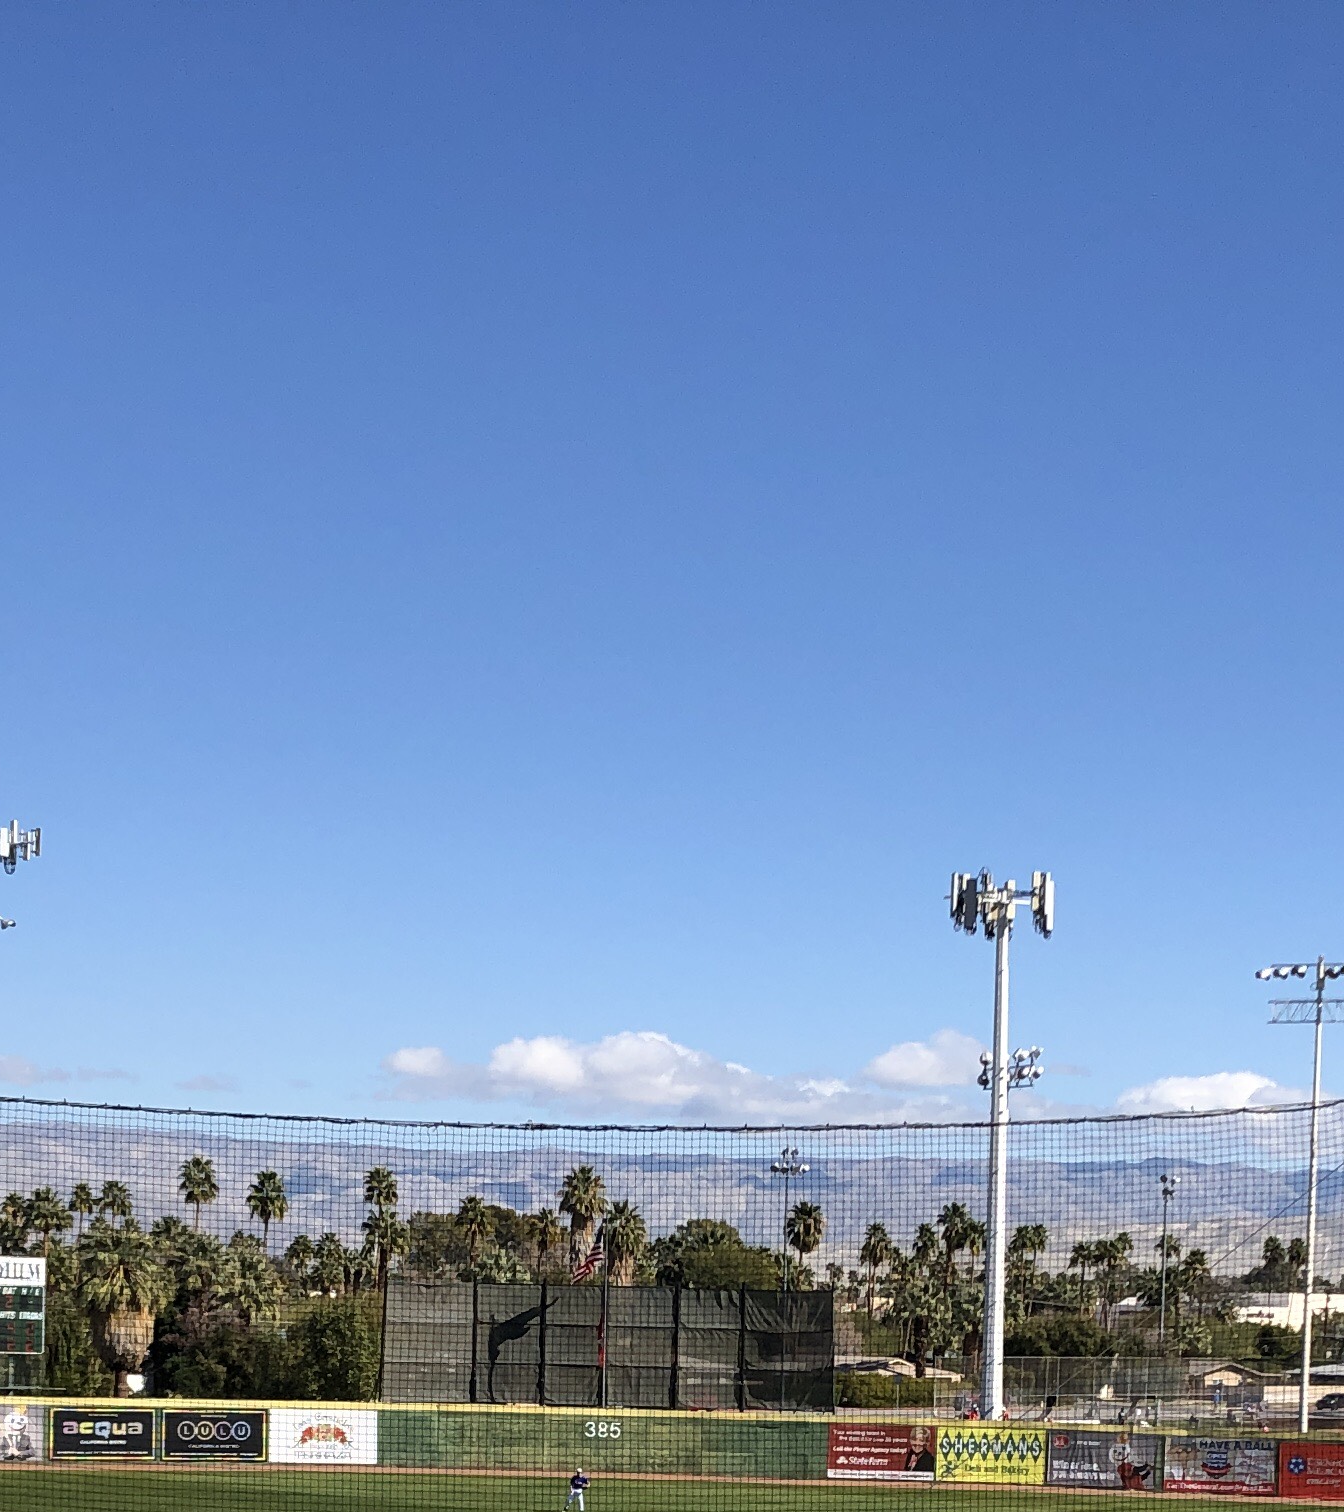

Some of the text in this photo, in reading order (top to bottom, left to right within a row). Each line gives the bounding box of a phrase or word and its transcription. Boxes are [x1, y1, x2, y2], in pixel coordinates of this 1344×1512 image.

[180, 1424, 248, 1438] LULU
[584, 1421, 622, 1439] 385
[942, 1434, 1040, 1456] SHERMAN'S
[1200, 1440, 1274, 1450] HAVE A BALL
